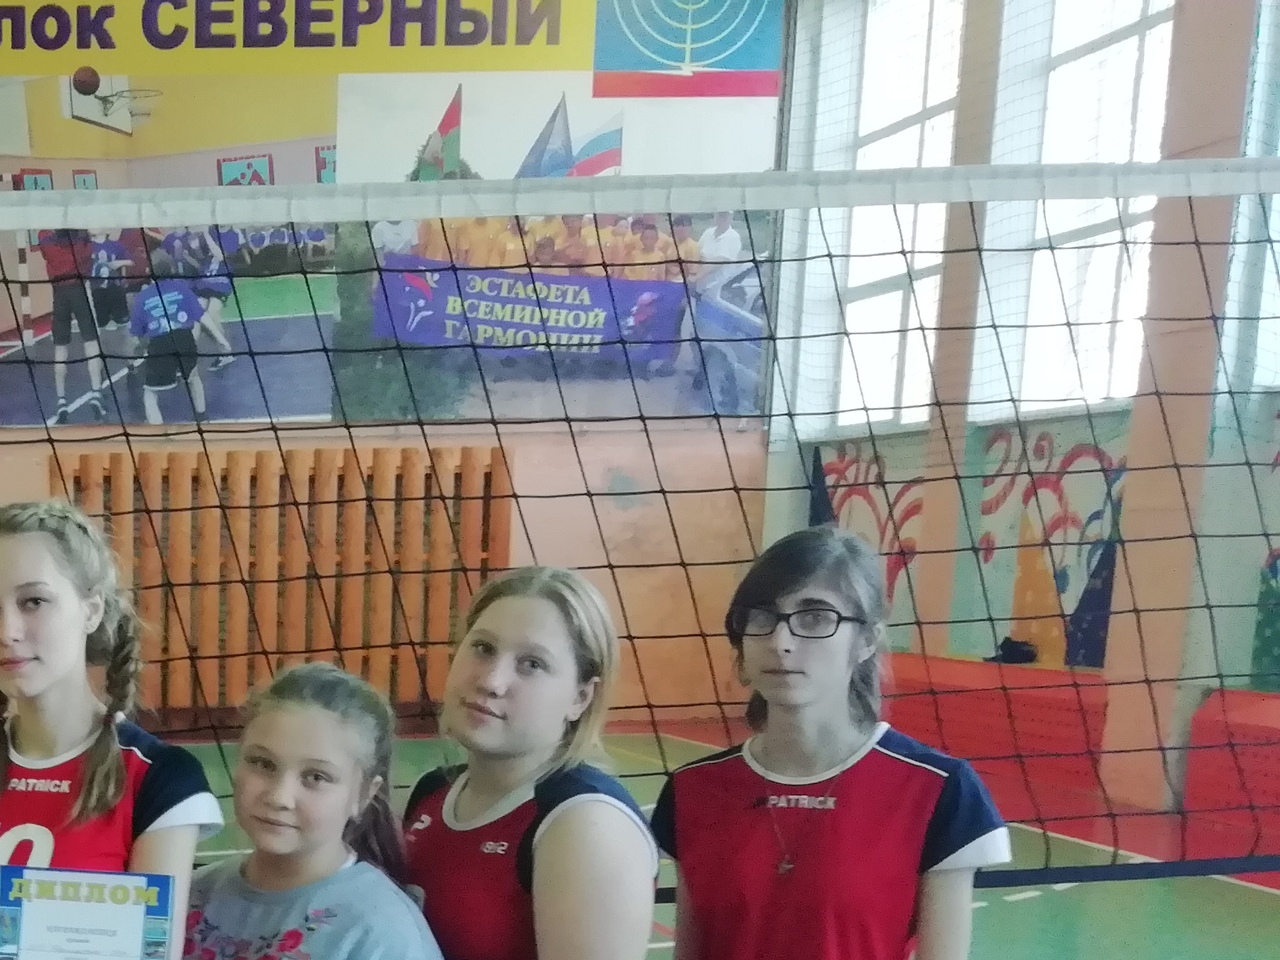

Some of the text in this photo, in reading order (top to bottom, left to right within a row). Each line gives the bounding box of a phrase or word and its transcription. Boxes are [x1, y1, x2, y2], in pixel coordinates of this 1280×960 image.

[464, 274, 592, 305] ЭСТАФЕТА
[445, 295, 607, 329] ВСЕМИРНОЙ
[8, 777, 72, 793] PATRICK
[767, 795, 837, 810] PATRICK
[9, 878, 159, 907] ДИПЛОМ
